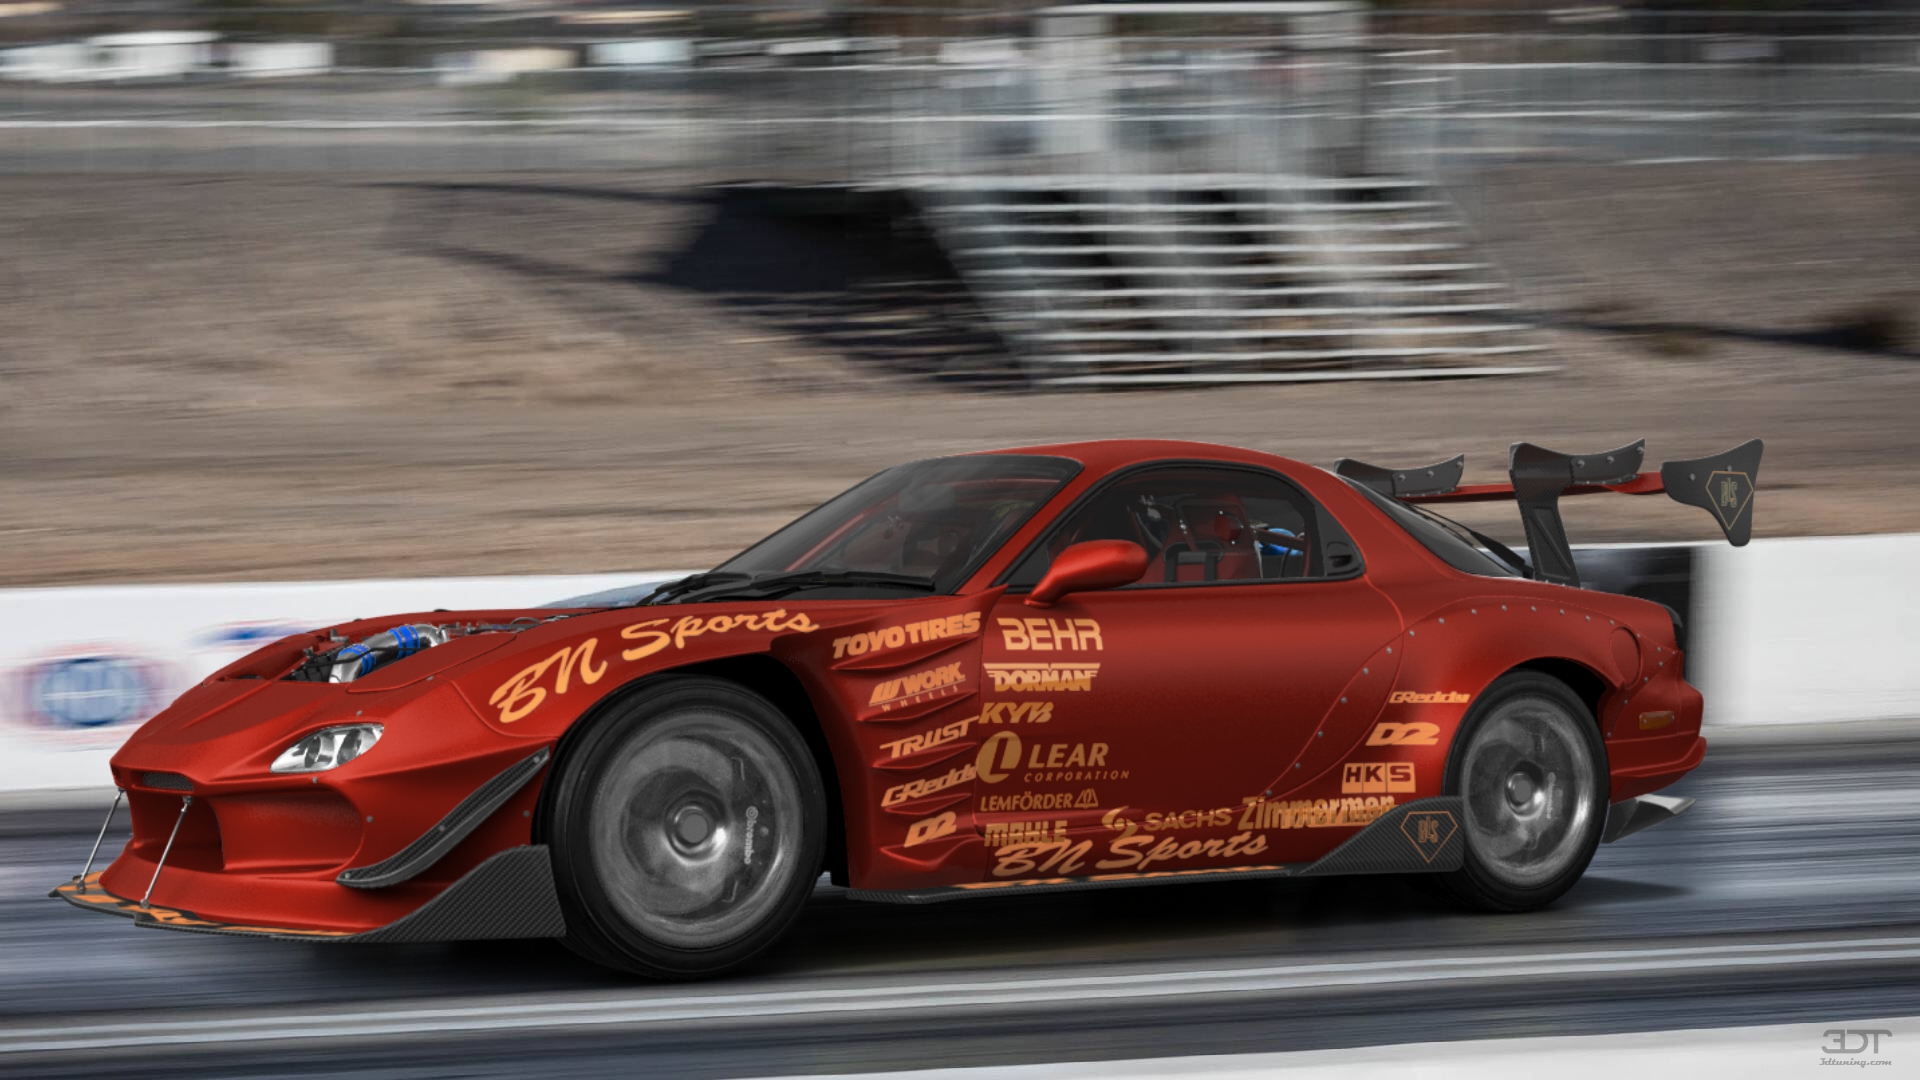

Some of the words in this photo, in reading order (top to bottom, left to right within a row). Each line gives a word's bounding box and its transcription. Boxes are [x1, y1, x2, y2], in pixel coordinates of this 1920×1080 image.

[832, 625, 906, 659] TOYO
[903, 611, 981, 643] TIRES
[997, 617, 1104, 651] BEHR
[489, 637, 608, 723] BN
[620, 608, 820, 661] Sports
[899, 661, 965, 693] WORK
[993, 668, 1093, 692] DORMAN
[881, 685, 959, 712] WHEELS
[978, 701, 1055, 724] KYB
[879, 714, 980, 759] TRUST
[1365, 721, 1441, 747] D2
[1027, 742, 1110, 769] LEAR
[1023, 769, 1130, 783] CORPORATION
[1345, 765, 1412, 783] HKS
[979, 792, 1074, 812] LEMFÖRDER
[903, 810, 958, 849] D2
[1143, 807, 1233, 832] SACHS
[983, 820, 1069, 847] MAHLE
[991, 838, 1094, 877] BN
[1095, 831, 1269, 871] Sports
